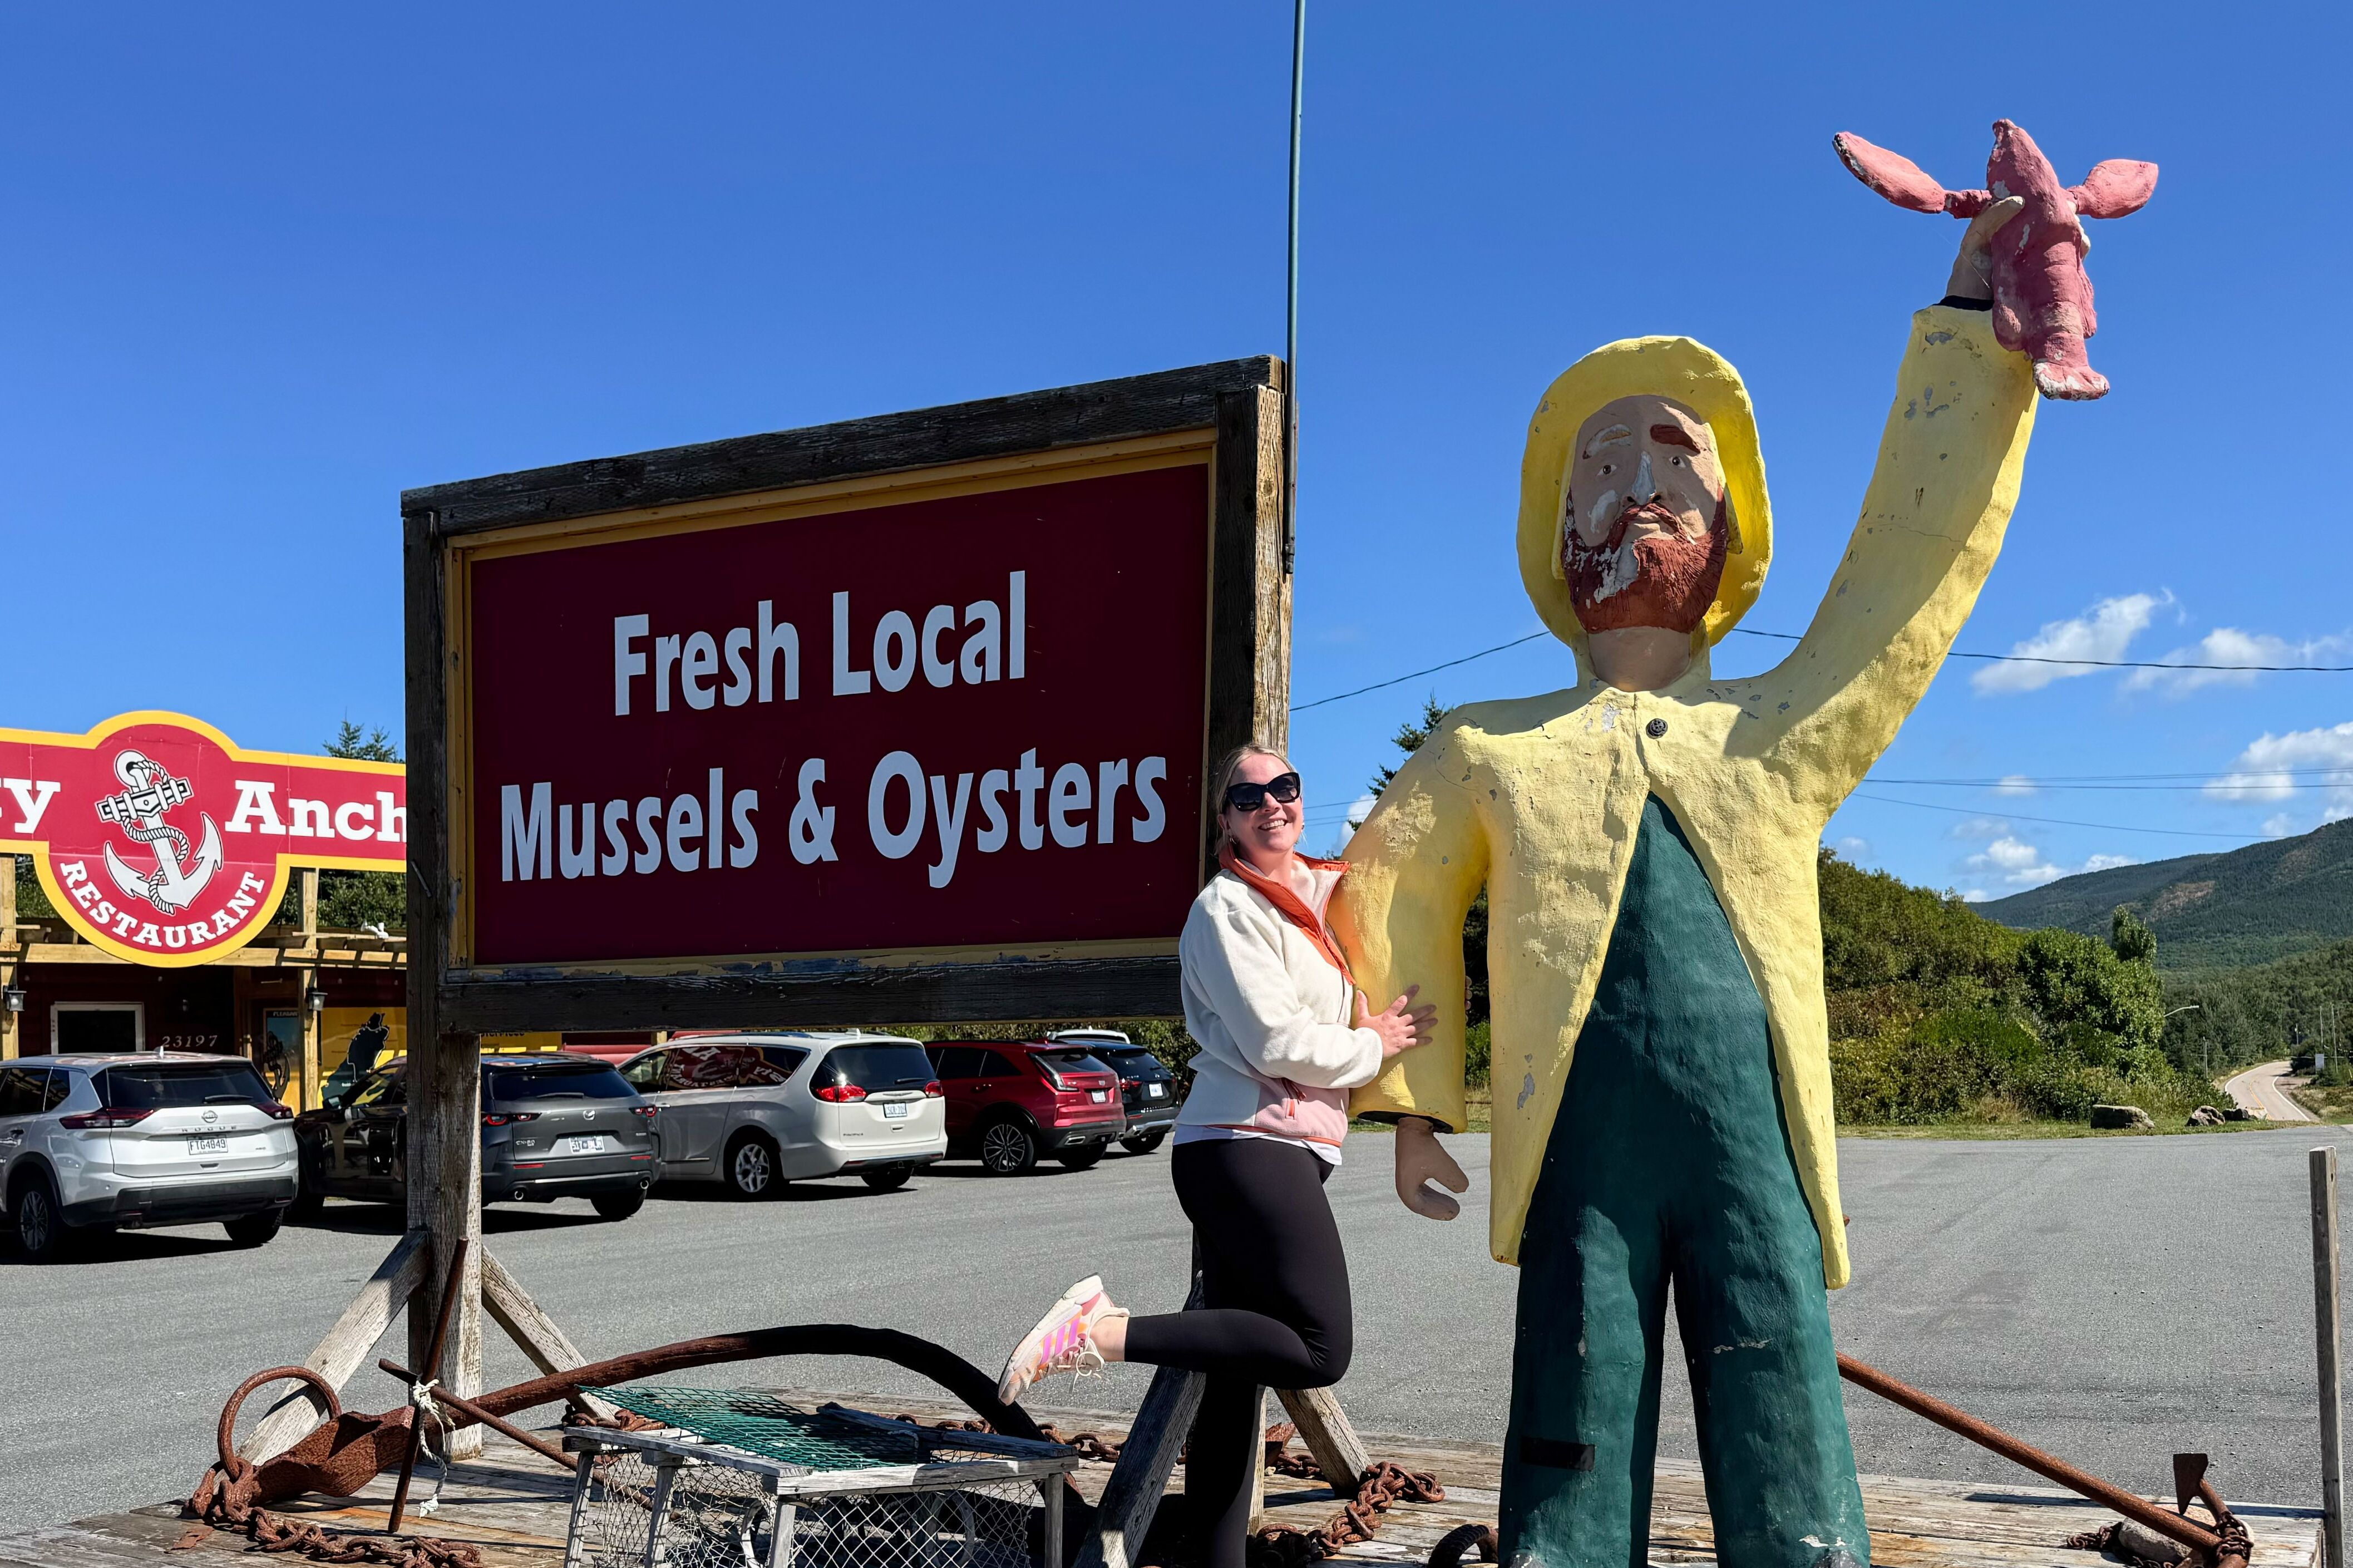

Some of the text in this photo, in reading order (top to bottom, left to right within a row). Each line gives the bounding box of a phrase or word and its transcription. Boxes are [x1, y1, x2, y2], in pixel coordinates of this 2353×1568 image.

[615, 571, 1025, 716] Fresh Local
[501, 747, 1167, 889] Mussels & Oysters
[60, 860, 265, 948] RESTAURANT
[161, 1035, 218, 1048] 23197
